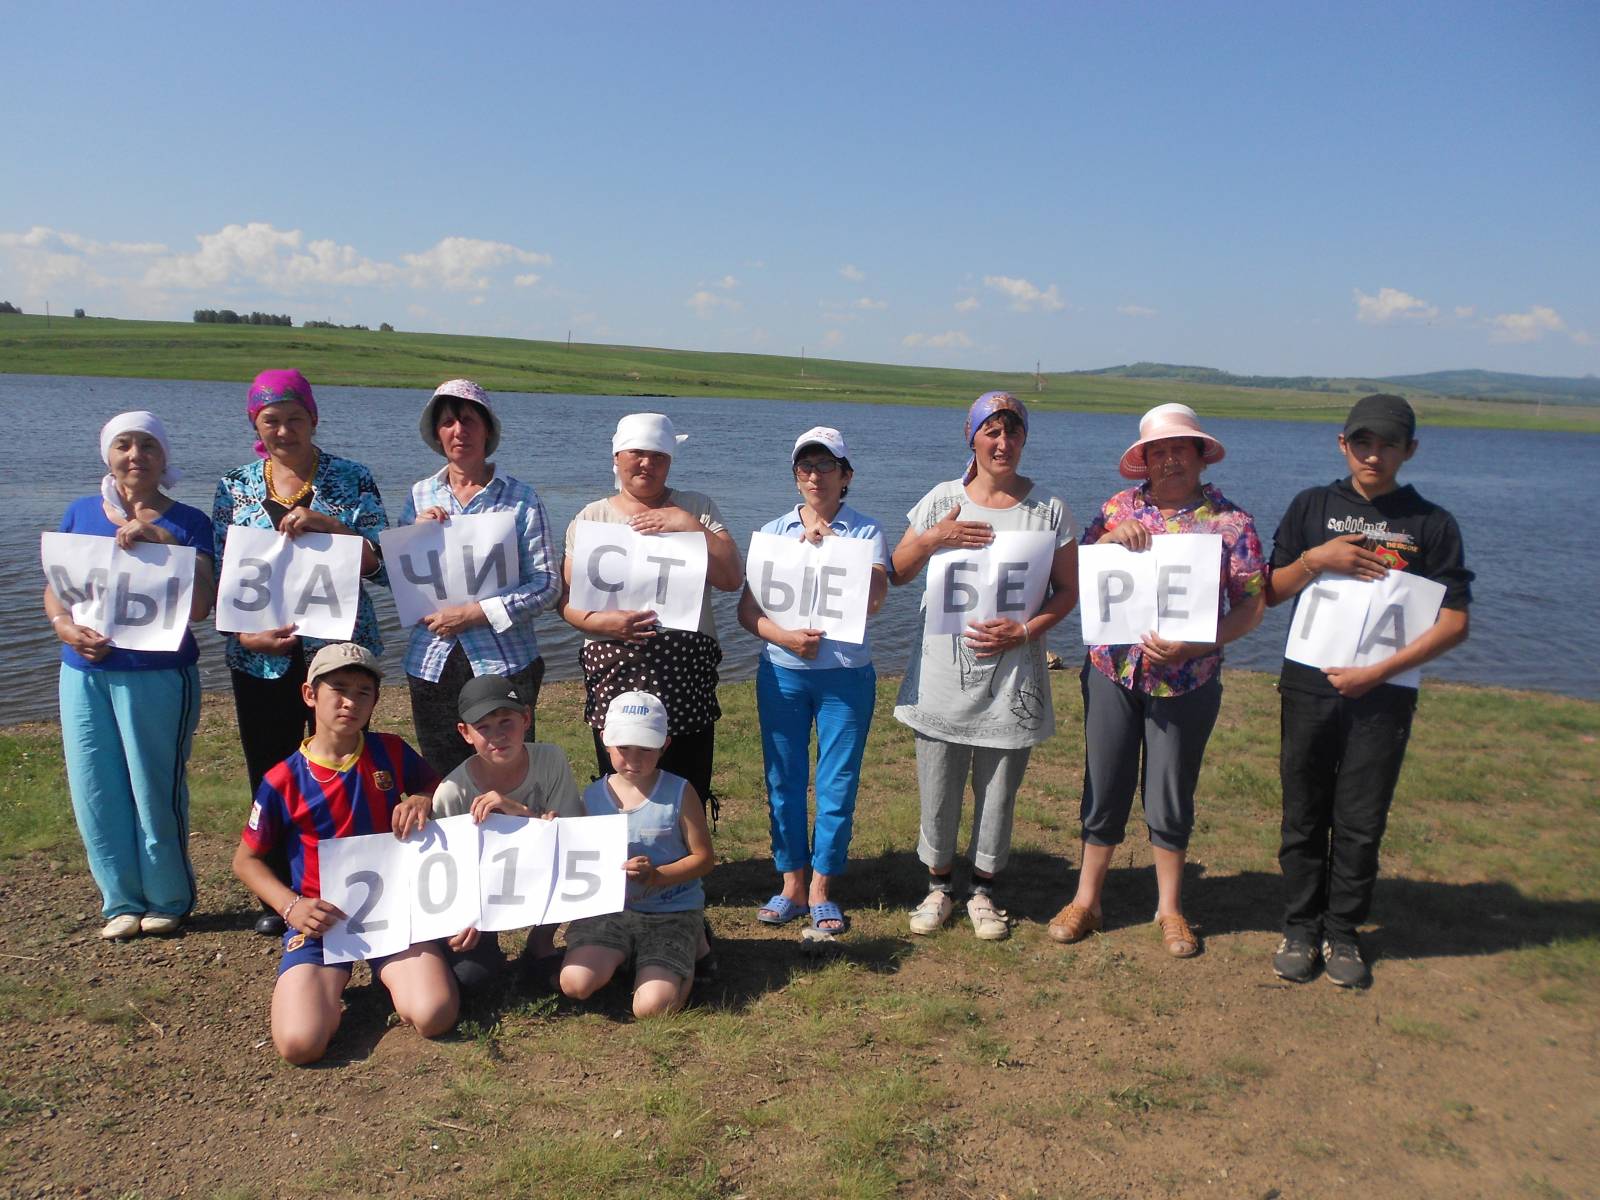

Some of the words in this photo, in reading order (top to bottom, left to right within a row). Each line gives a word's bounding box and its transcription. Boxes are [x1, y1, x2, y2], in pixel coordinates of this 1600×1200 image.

[49, 565, 181, 631] МЫ
[232, 557, 343, 619] ЗА
[344, 846, 602, 935] 2015
